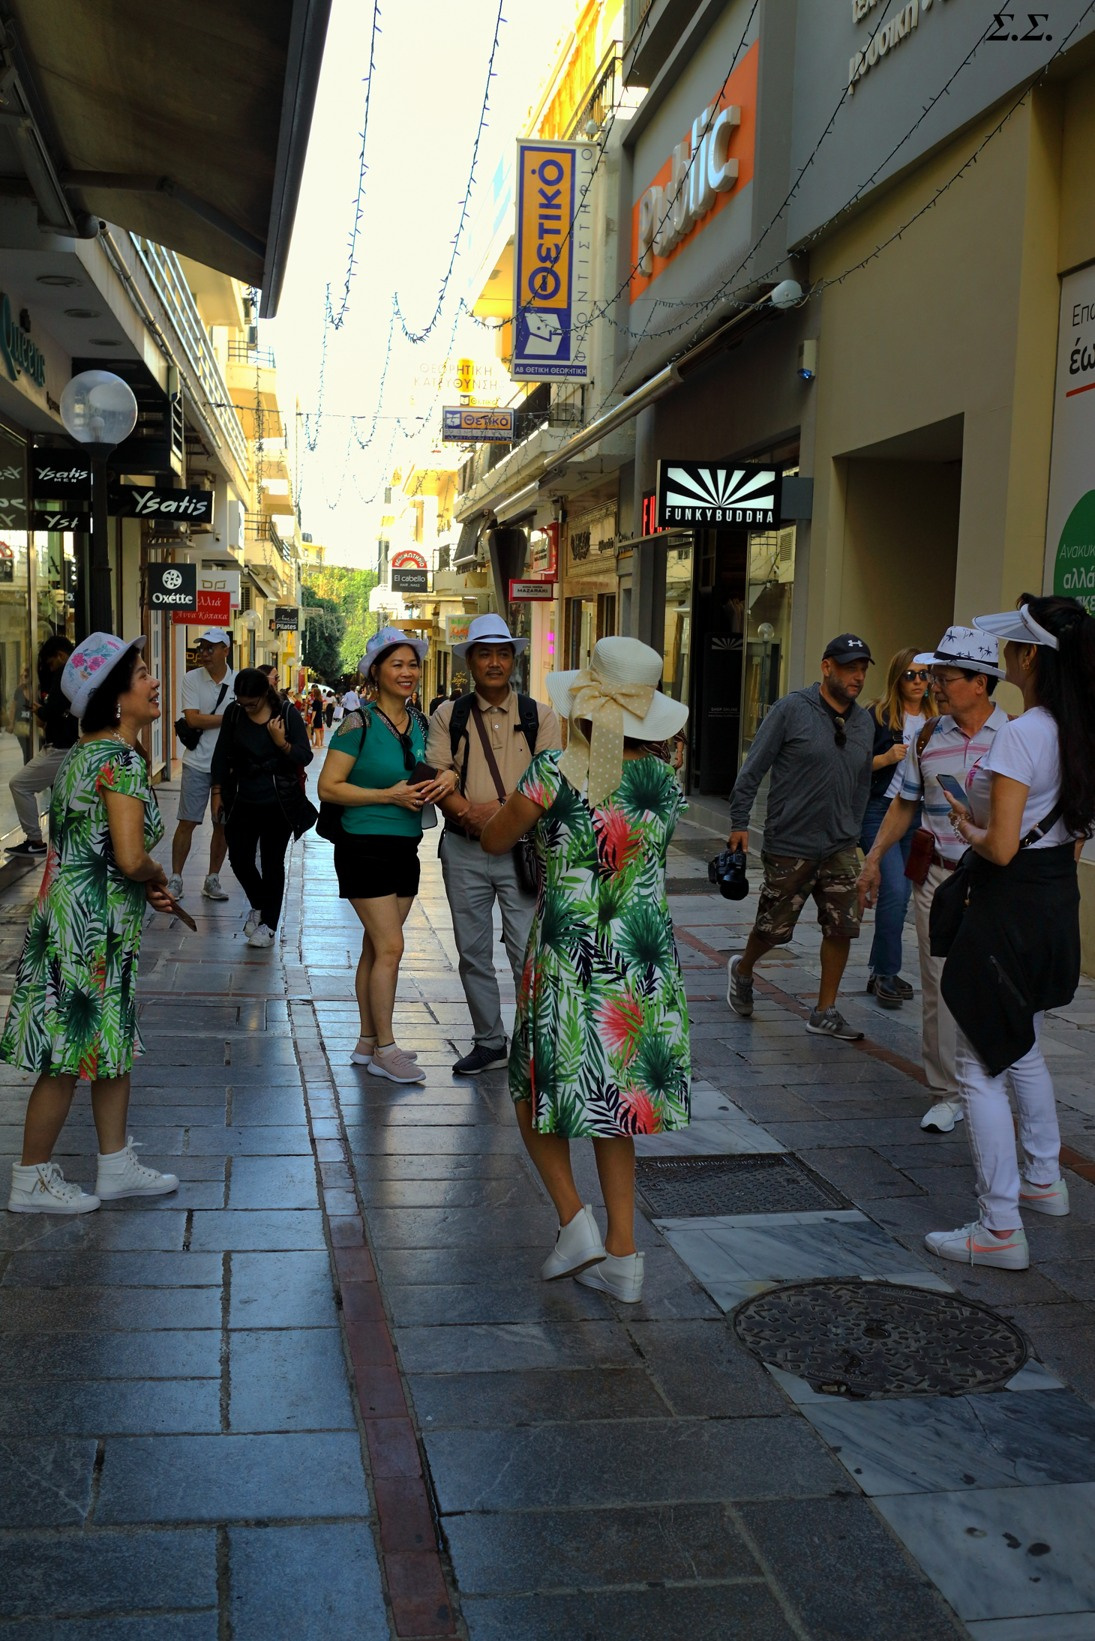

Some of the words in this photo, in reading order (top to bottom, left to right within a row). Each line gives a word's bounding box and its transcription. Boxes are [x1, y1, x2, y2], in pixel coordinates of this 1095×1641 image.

[638, 104, 741, 277] public
[575, 148, 593, 363] ΦΡΟΝΤΙΣΤΗΡΙΟ
[525, 366, 549, 374] ΘΕΤΙΚΗ
[550, 367, 587, 375] ΘΕΩΡΗΤΙΚΗ
[35, 466, 88, 480] Ysatis
[131, 490, 208, 516] Ysatis
[665, 507, 774, 524] FUNKYBUDDHA
[152, 592, 193, 604] Oxétte
